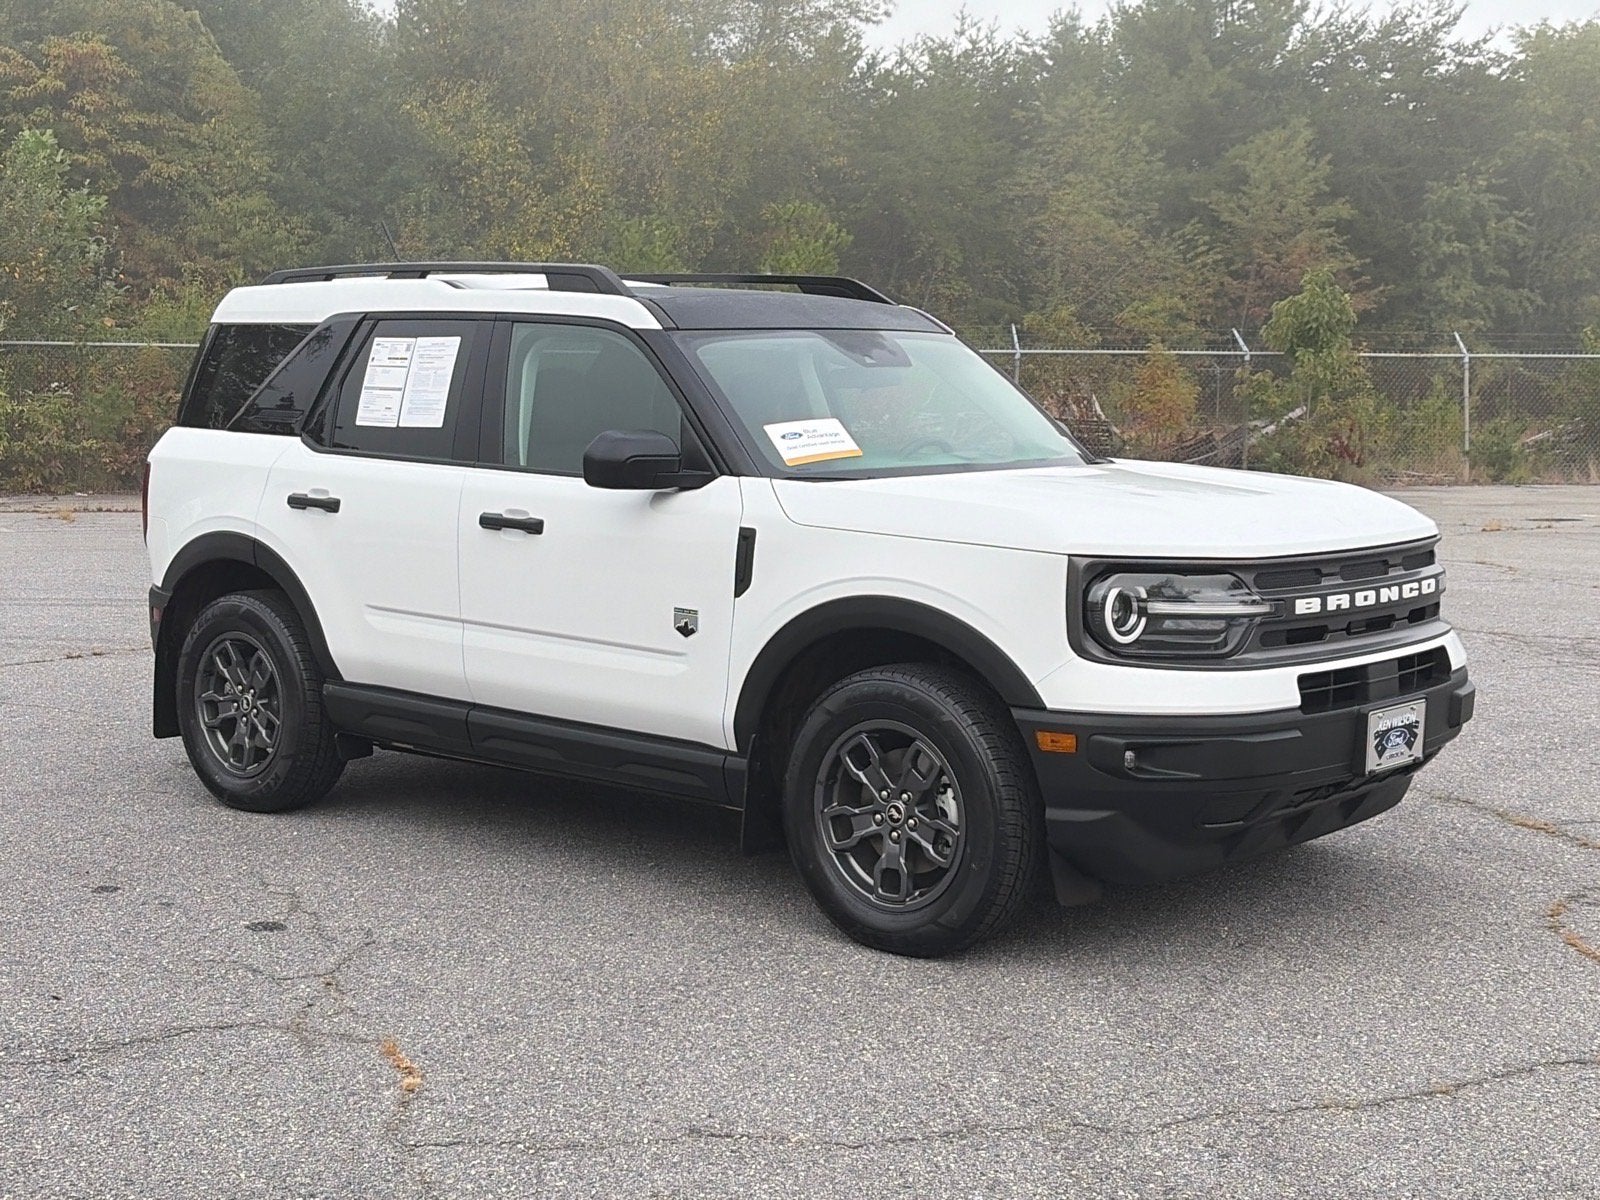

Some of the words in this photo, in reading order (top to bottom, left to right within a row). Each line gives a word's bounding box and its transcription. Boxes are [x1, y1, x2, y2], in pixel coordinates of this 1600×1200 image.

[1295, 578, 1436, 615] BRONCO
[1378, 719, 1393, 731] KEN
[1387, 731, 1406, 747] Ford
